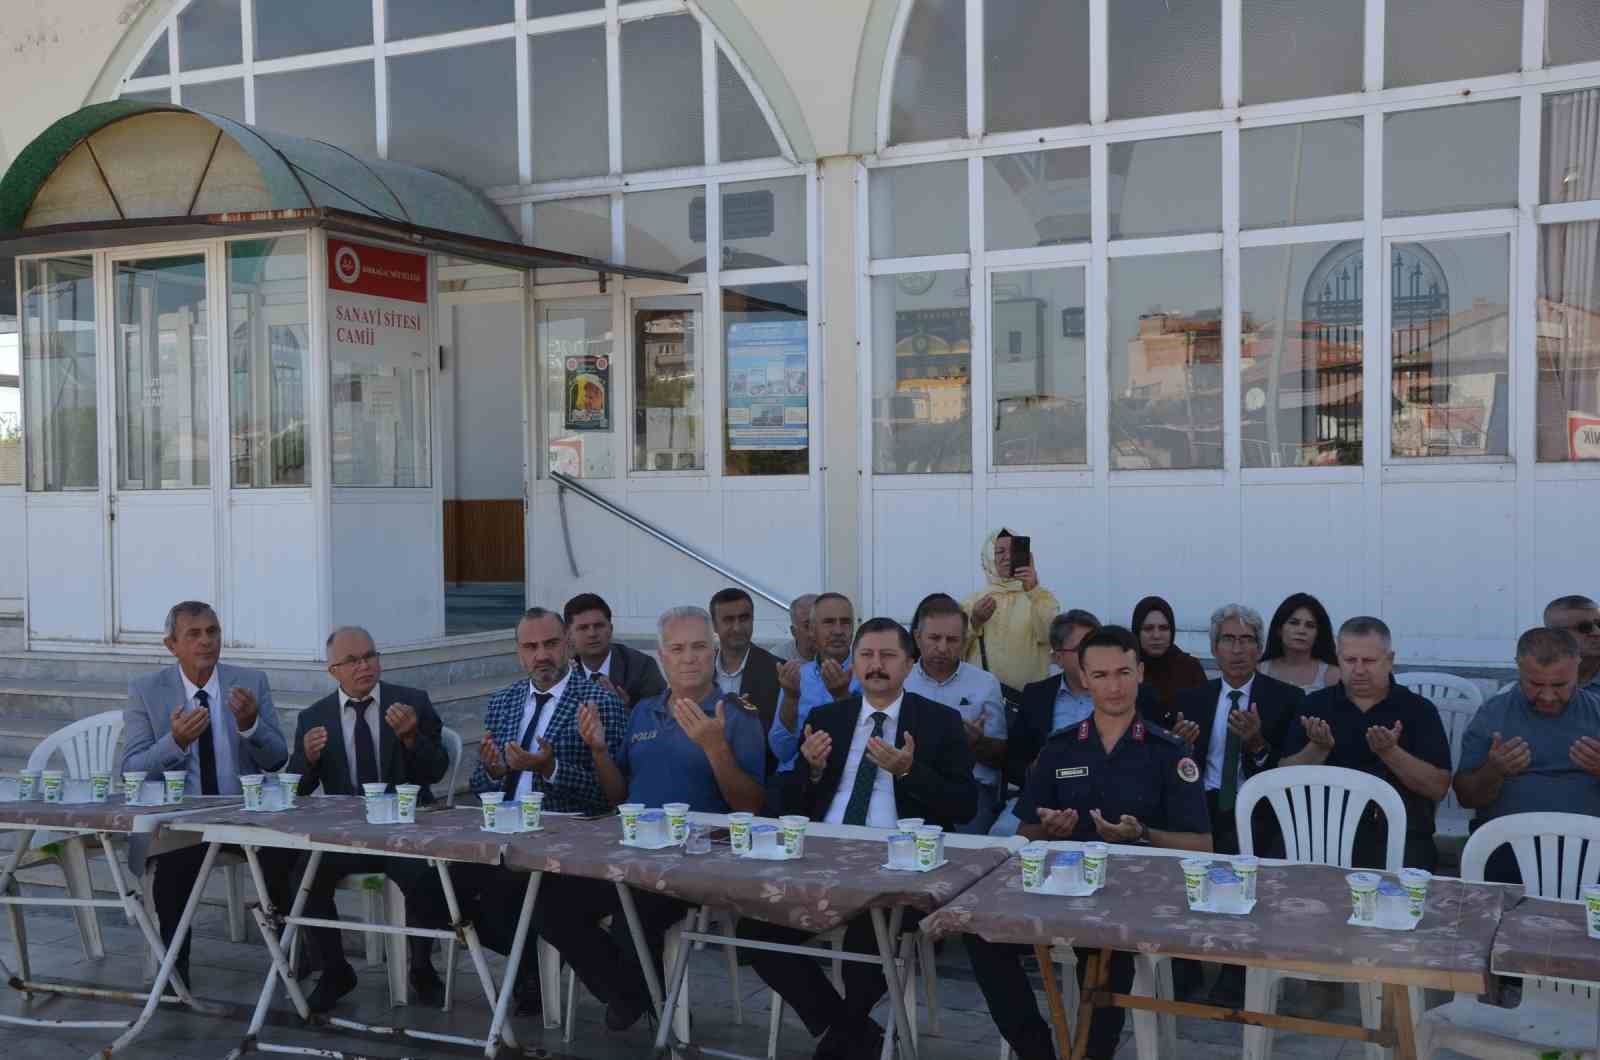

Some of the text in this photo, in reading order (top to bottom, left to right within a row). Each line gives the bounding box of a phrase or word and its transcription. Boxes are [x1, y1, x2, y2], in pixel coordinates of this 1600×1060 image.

[336, 304, 421, 331] SANAYİ SİTESİ
[336, 327, 375, 346] CAMİİ
